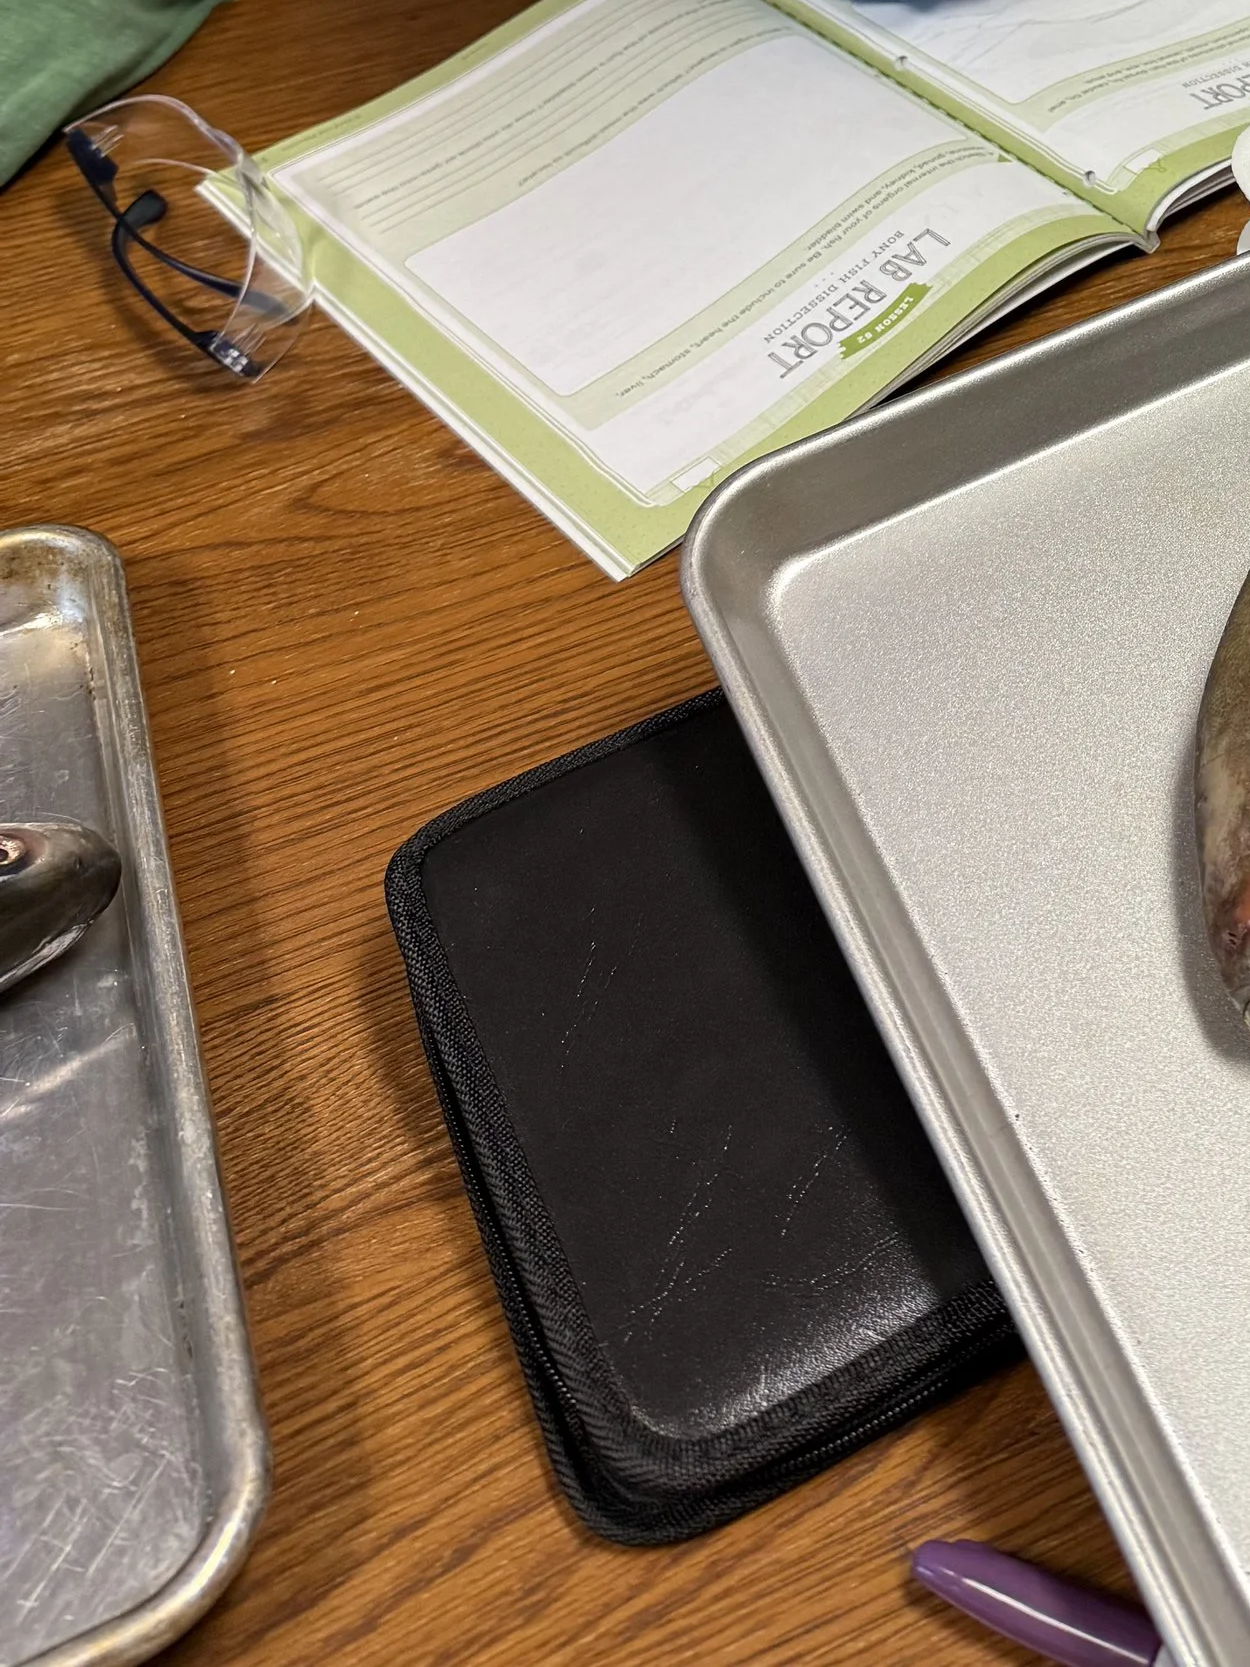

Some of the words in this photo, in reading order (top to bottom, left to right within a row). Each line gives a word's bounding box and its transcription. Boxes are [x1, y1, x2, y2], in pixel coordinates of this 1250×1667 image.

[879, 165, 916, 193] kidney,
[902, 163, 939, 190] internal
[862, 187, 885, 207] and
[871, 184, 905, 212] organs
[838, 214, 863, 236] your
[839, 202, 867, 226] swim
[859, 207, 875, 222] of
[802, 220, 843, 255] bladder.
[819, 232, 844, 254] fish.
[869, 228, 904, 259] BONY
[784, 258, 809, 280] sure
[805, 249, 822, 265] Be
[877, 227, 951, 284] LAB
[772, 276, 788, 291] to
[835, 255, 870, 286] FISH
[739, 285, 777, 316] include
[761, 281, 839, 345] DISSECTION
[871, 293, 916, 335] LESSON
[719, 309, 743, 330] the
[763, 283, 883, 379] REPORT
[690, 323, 724, 350] heart,
[640, 344, 691, 384] stomach,
[613, 377, 644, 401] liver,
